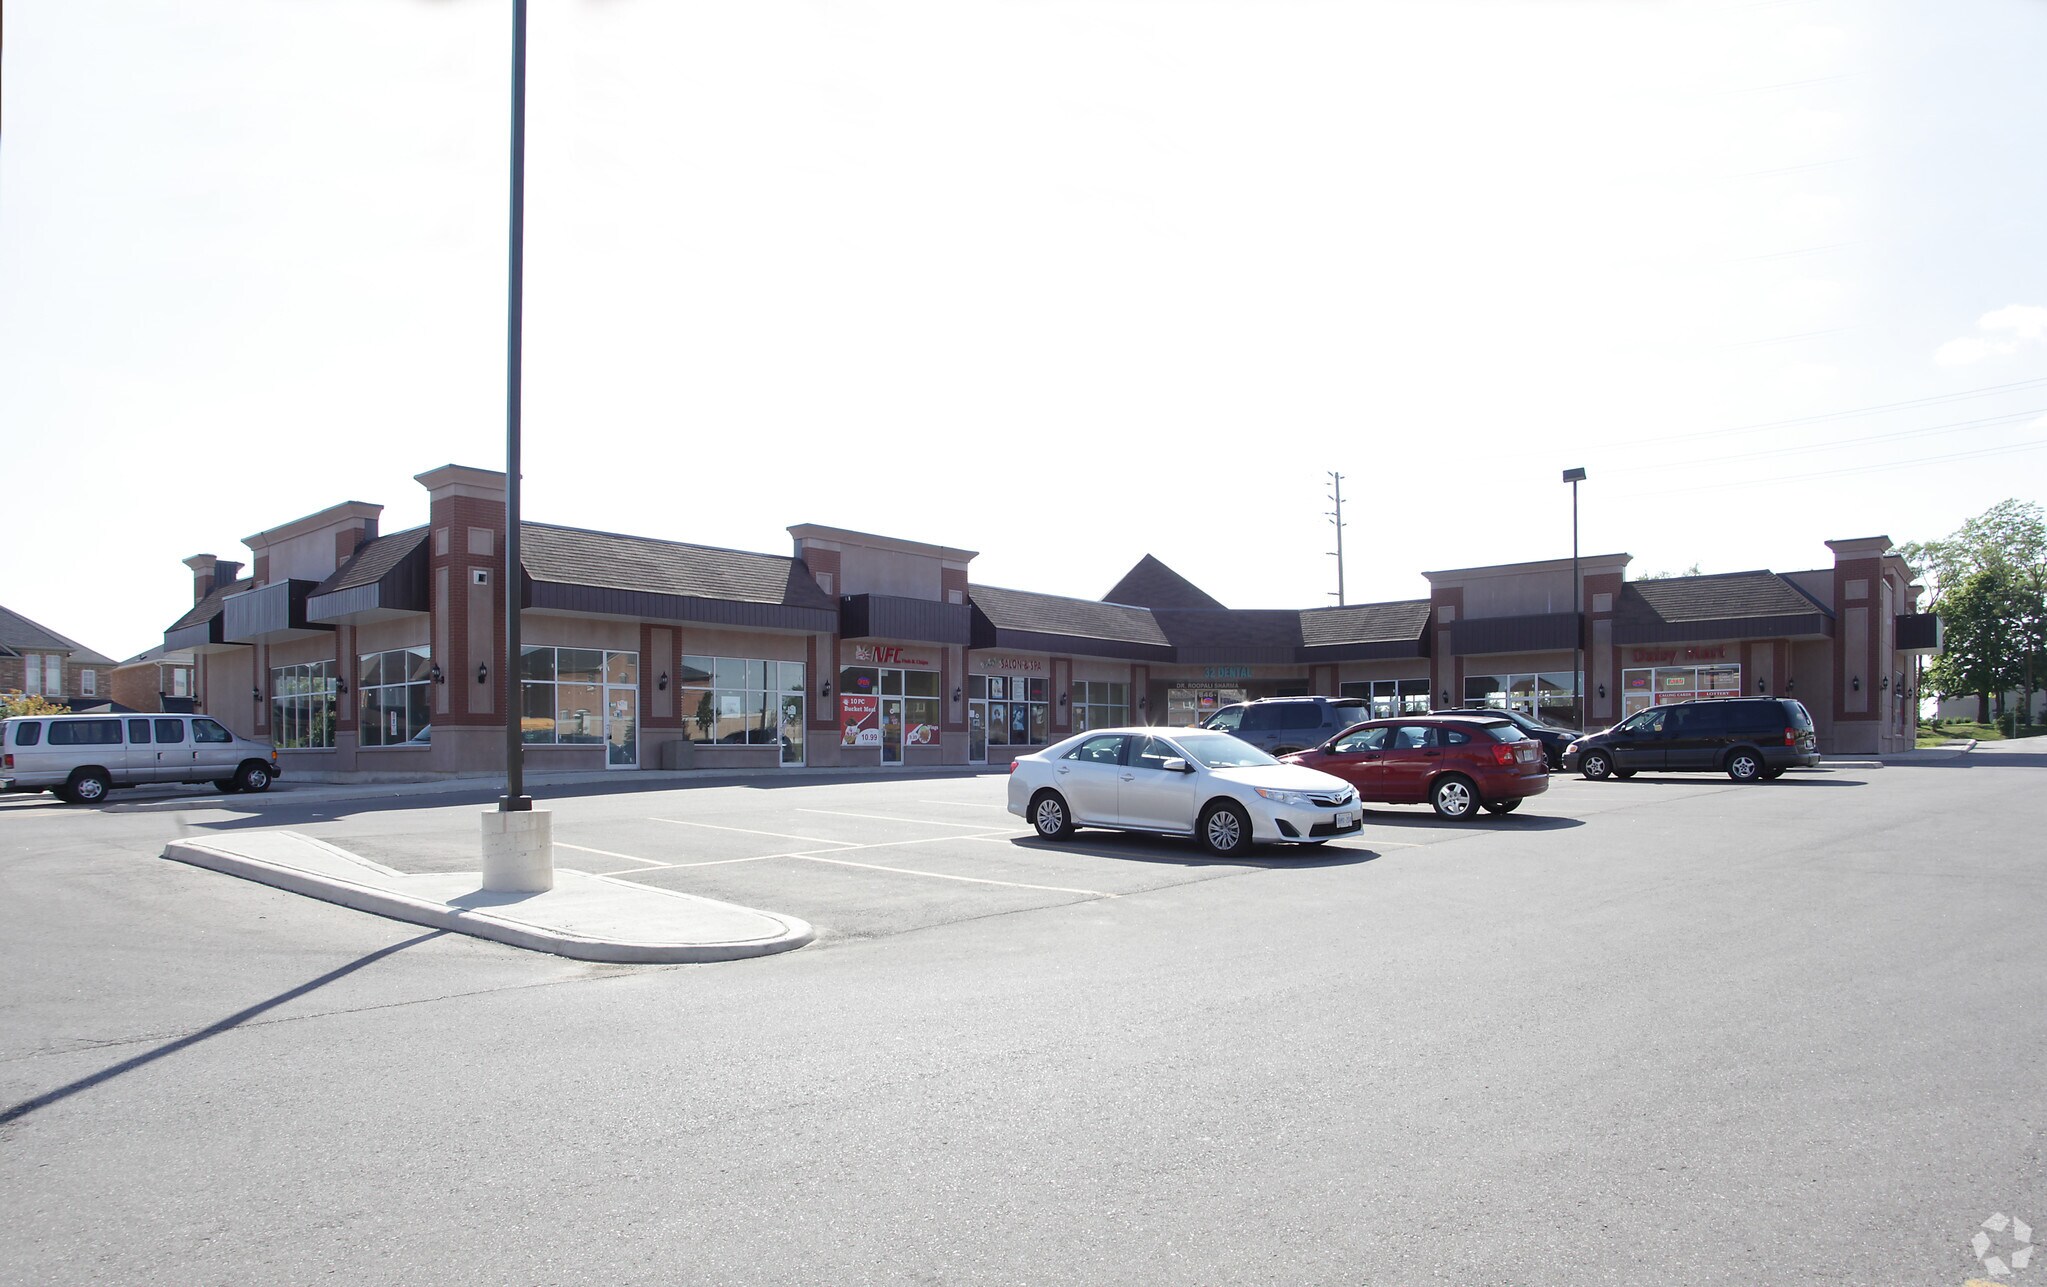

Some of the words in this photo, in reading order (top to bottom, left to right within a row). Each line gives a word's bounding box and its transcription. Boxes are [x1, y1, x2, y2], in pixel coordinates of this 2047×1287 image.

[871, 646, 903, 664] NFC
[1000, 658, 1022, 669] SALON
[1029, 660, 1042, 671] SPA
[1204, 666, 1216, 678] 32
[1218, 666, 1252, 679] DENTAL
[861, 733, 878, 741] 10.99
